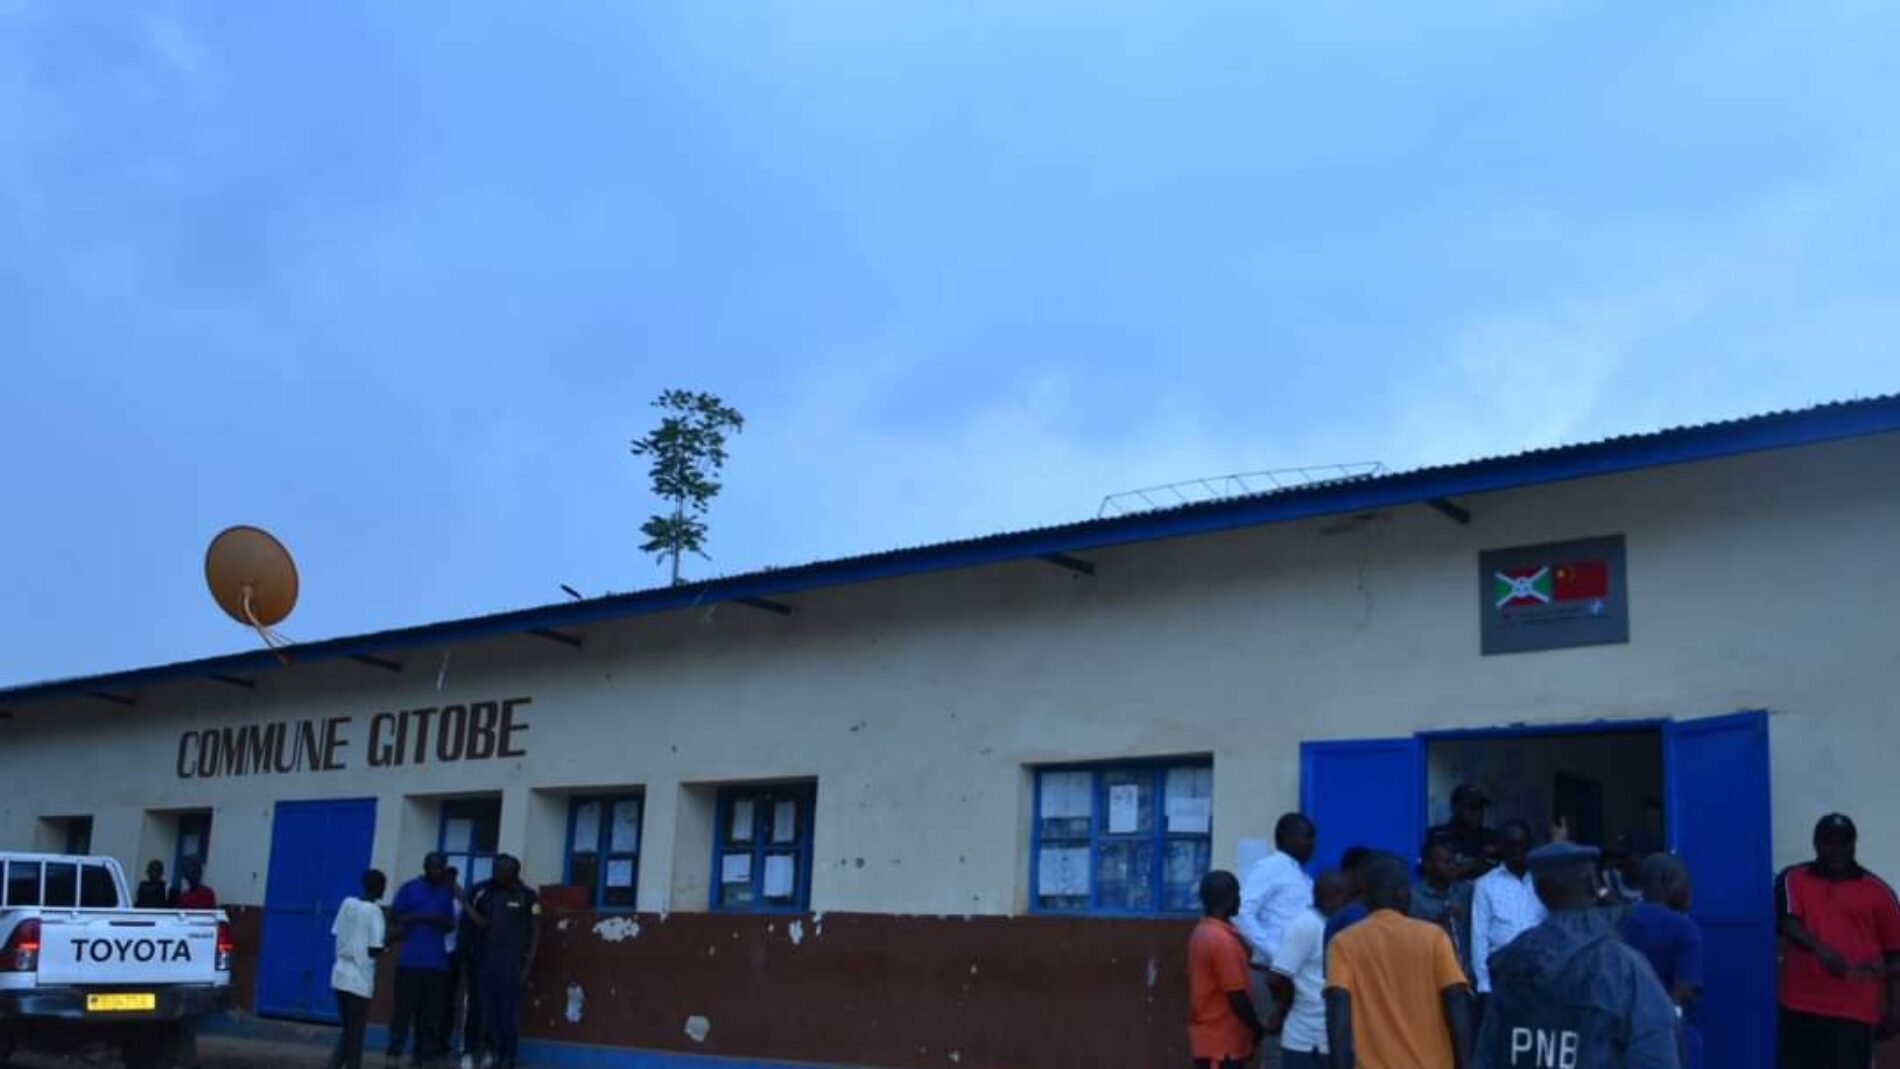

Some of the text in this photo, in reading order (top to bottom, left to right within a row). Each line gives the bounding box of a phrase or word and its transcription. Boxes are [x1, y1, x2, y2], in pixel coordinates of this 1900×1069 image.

[177, 697, 532, 778] COMMUNE GITOBE
[71, 938, 191, 963] TOYOTA
[1511, 1027, 1579, 1069] PNB
